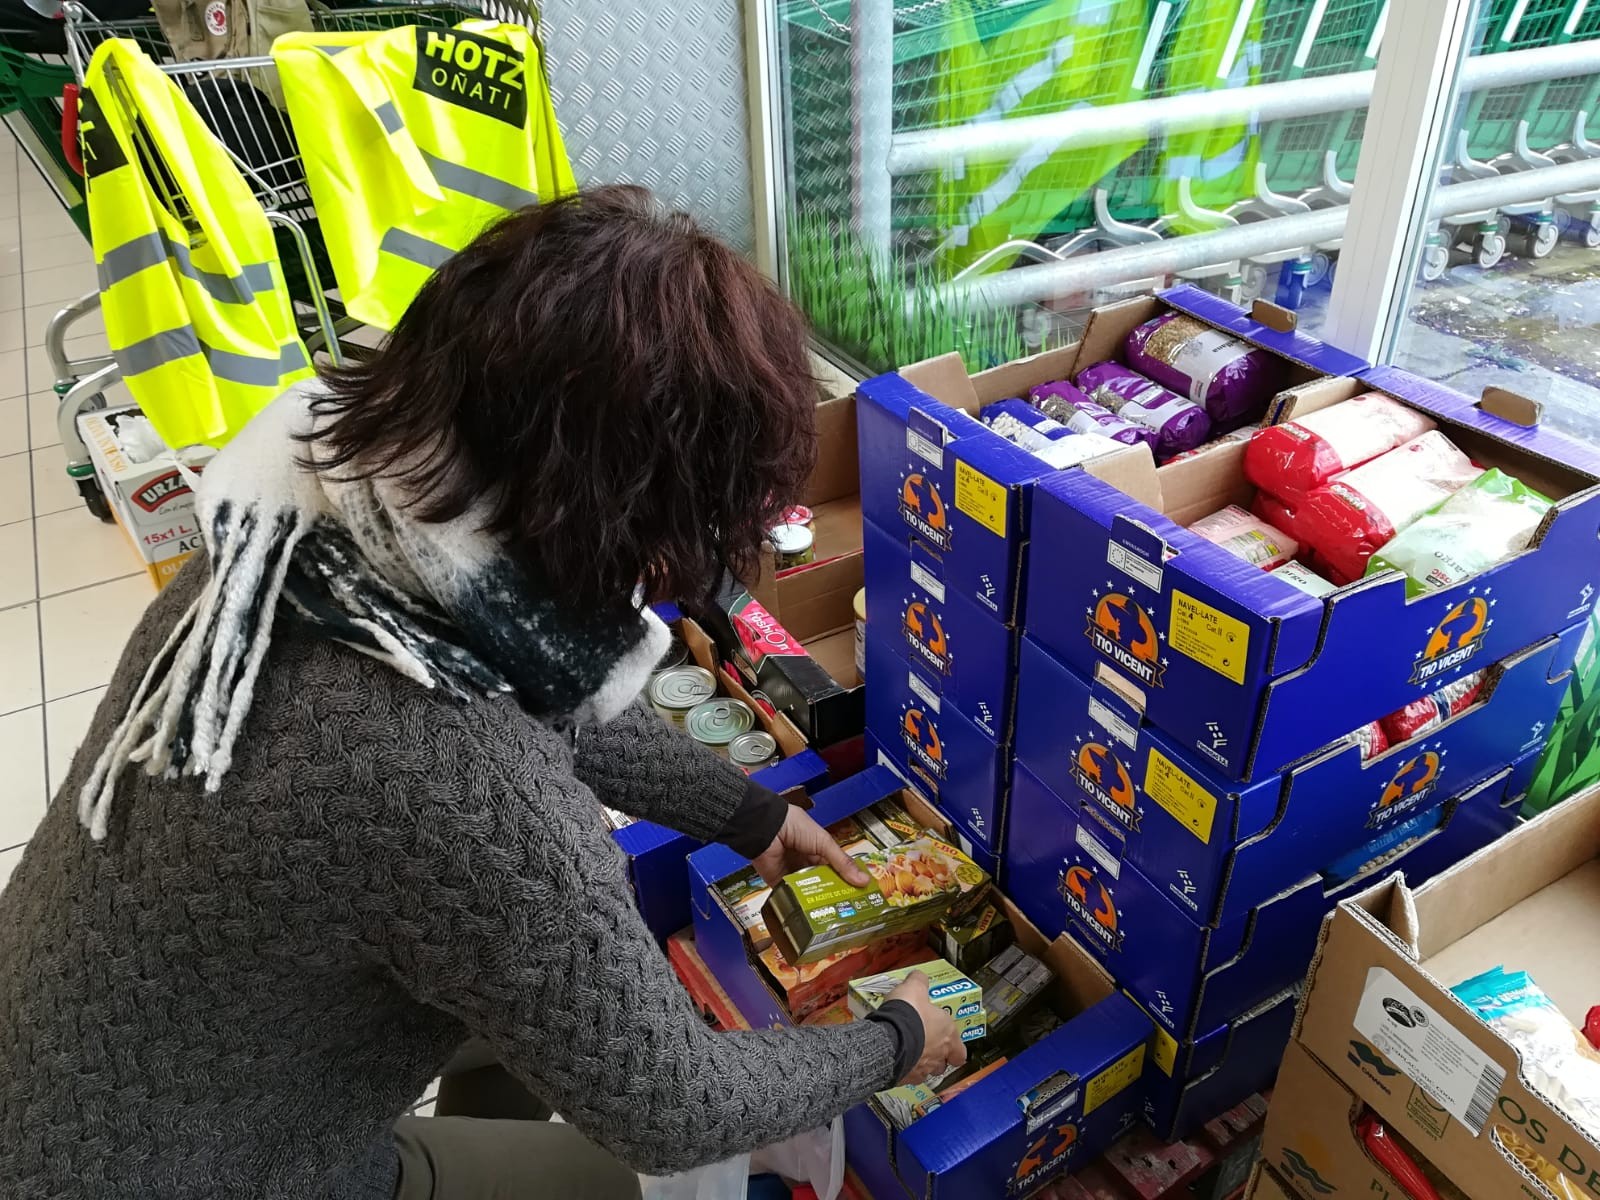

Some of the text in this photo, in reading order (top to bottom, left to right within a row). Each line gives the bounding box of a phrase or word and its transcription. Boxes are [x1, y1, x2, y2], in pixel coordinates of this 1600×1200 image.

[425, 31, 524, 90] HOTZ
[431, 68, 511, 110] OÑATI
[144, 528, 176, 545] 15x1
[179, 534, 204, 554] AC
[917, 518, 945, 547] VICENT
[1177, 598, 1219, 625] NAVEL-LATE
[1095, 632, 1114, 655] TIO
[1113, 644, 1153, 682] VICENT
[1420, 643, 1475, 680] TIO VICENT
[1079, 773, 1096, 795] TIO
[1095, 787, 1132, 825] VICENT
[1393, 787, 1430, 815] VICENT
[1066, 892, 1113, 943] TIO VICENT
[931, 981, 973, 996] Calvo
[1498, 1096, 1548, 1144] OS
[1036, 1146, 1073, 1177] VICENT
